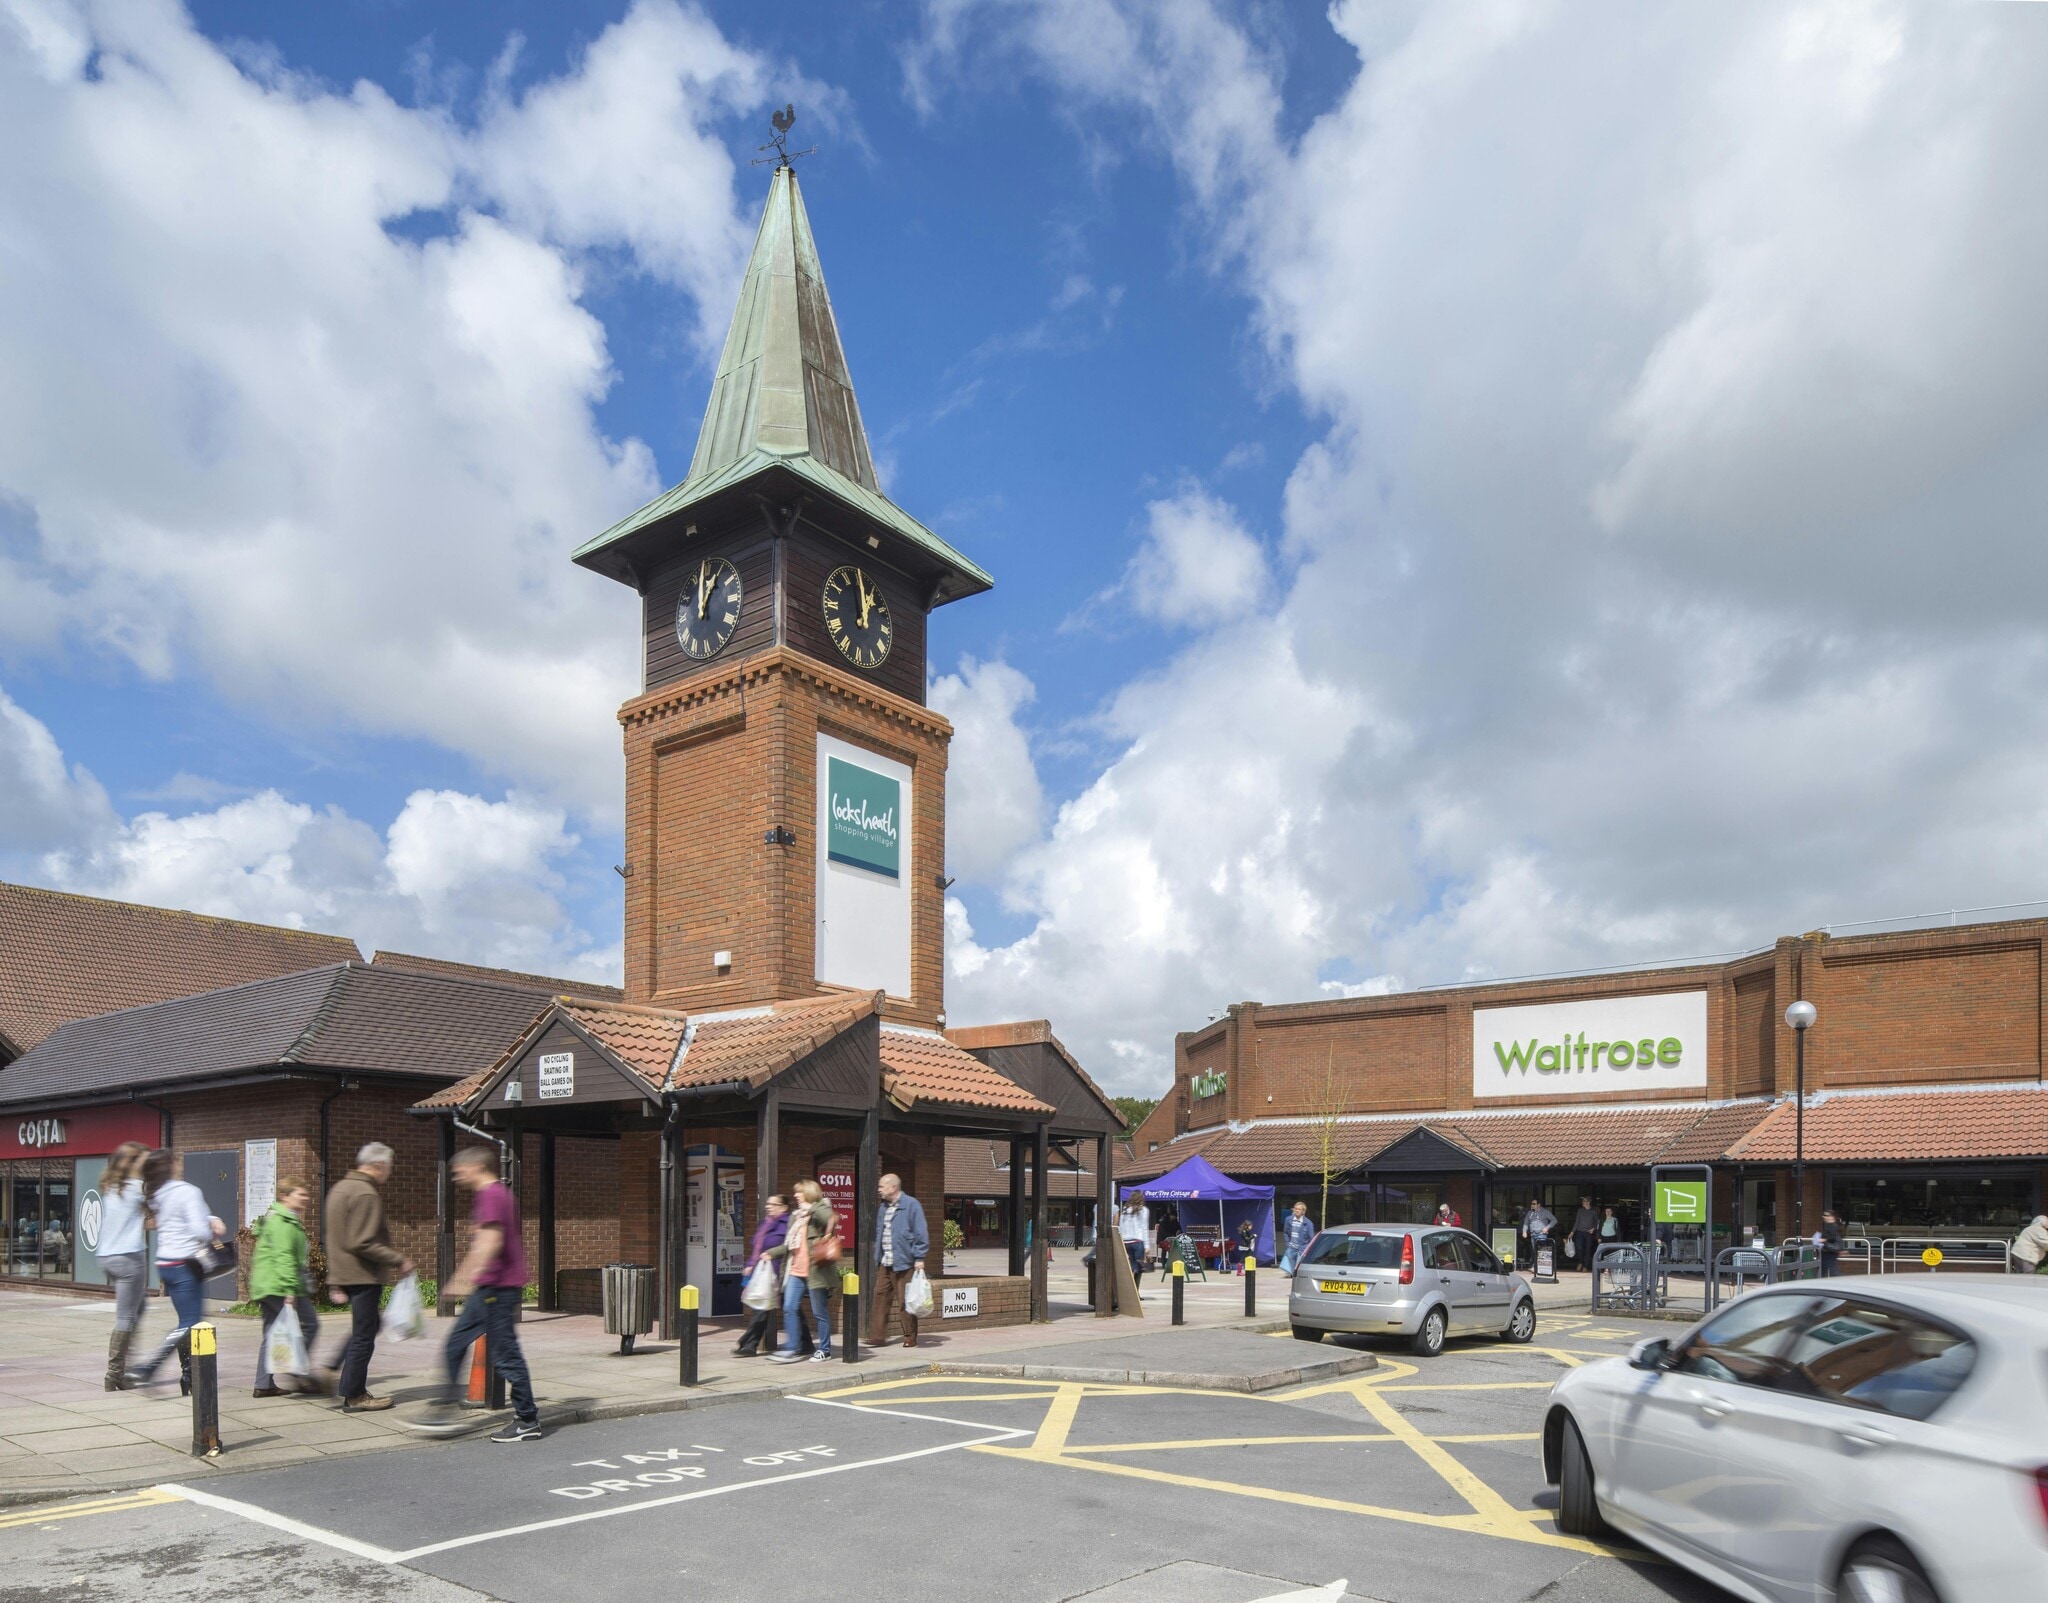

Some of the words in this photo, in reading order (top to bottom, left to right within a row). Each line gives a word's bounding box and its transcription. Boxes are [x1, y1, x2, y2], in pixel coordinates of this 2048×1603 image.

[834, 823, 869, 840] shopping
[870, 833, 894, 847] village
[1494, 1031, 1682, 1073] Waitrose
[544, 1056, 550, 1064] NO
[551, 1054, 569, 1063] CYCLING
[544, 1067, 561, 1075] SKATING
[551, 1077, 565, 1085] GAMES
[1191, 1067, 1227, 1100] Waitros
[552, 1088, 571, 1096] PRECINCT
[18, 1118, 66, 1149] COSTA
[820, 1175, 852, 1186] COSTA
[1324, 1281, 1344, 1290] RV04
[1346, 1283, 1362, 1292] XGA
[956, 1292, 966, 1300] NO
[945, 1304, 977, 1313] PARKING
[570, 1444, 725, 1469] TAXI
[548, 1466, 707, 1500] DROP
[742, 1444, 838, 1466] OFF
